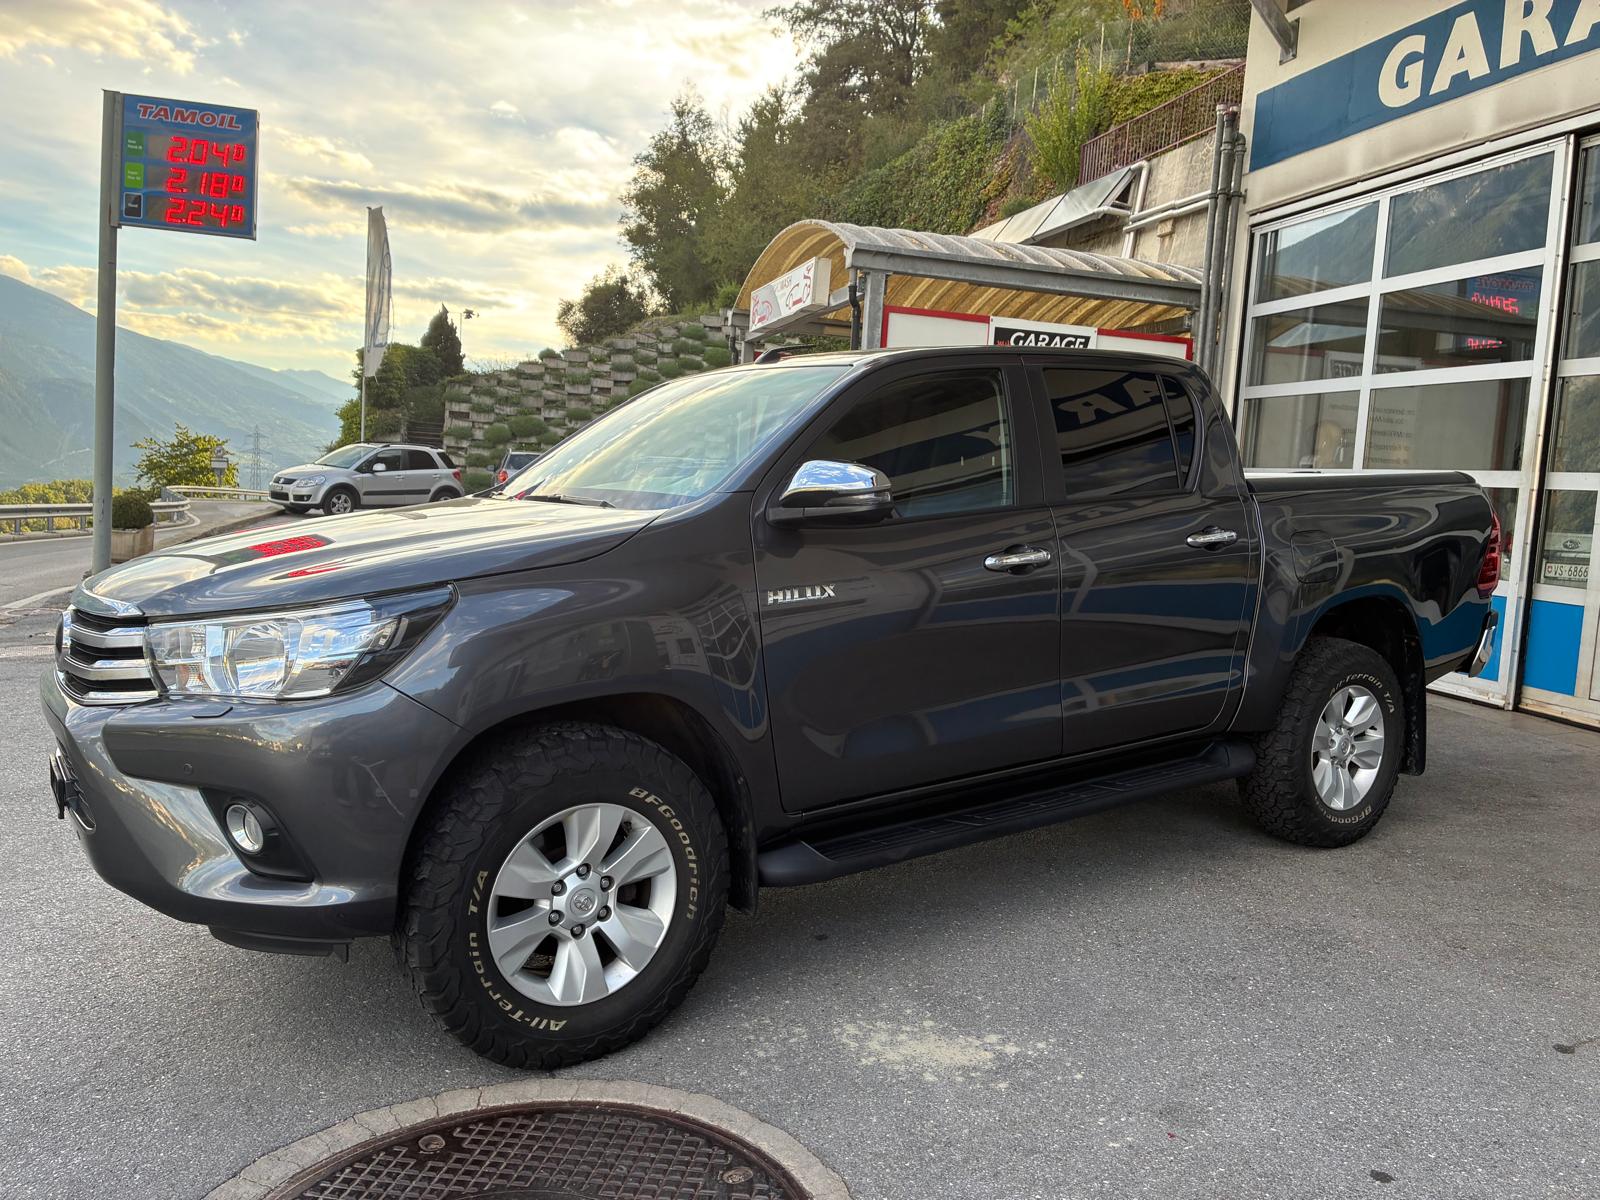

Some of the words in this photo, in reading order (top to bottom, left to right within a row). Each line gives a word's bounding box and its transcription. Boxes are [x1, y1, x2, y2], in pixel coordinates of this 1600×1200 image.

[137, 103, 242, 131] TAMOIL
[1010, 332, 1085, 349] GARAGE
[768, 583, 836, 605] HILUX
[1329, 672, 1384, 698] All-Terrain
[1383, 692, 1396, 714] T/A
[628, 786, 701, 921] BFGoodrich
[467, 869, 489, 917] T/A
[468, 931, 569, 1032] All-Terrain
